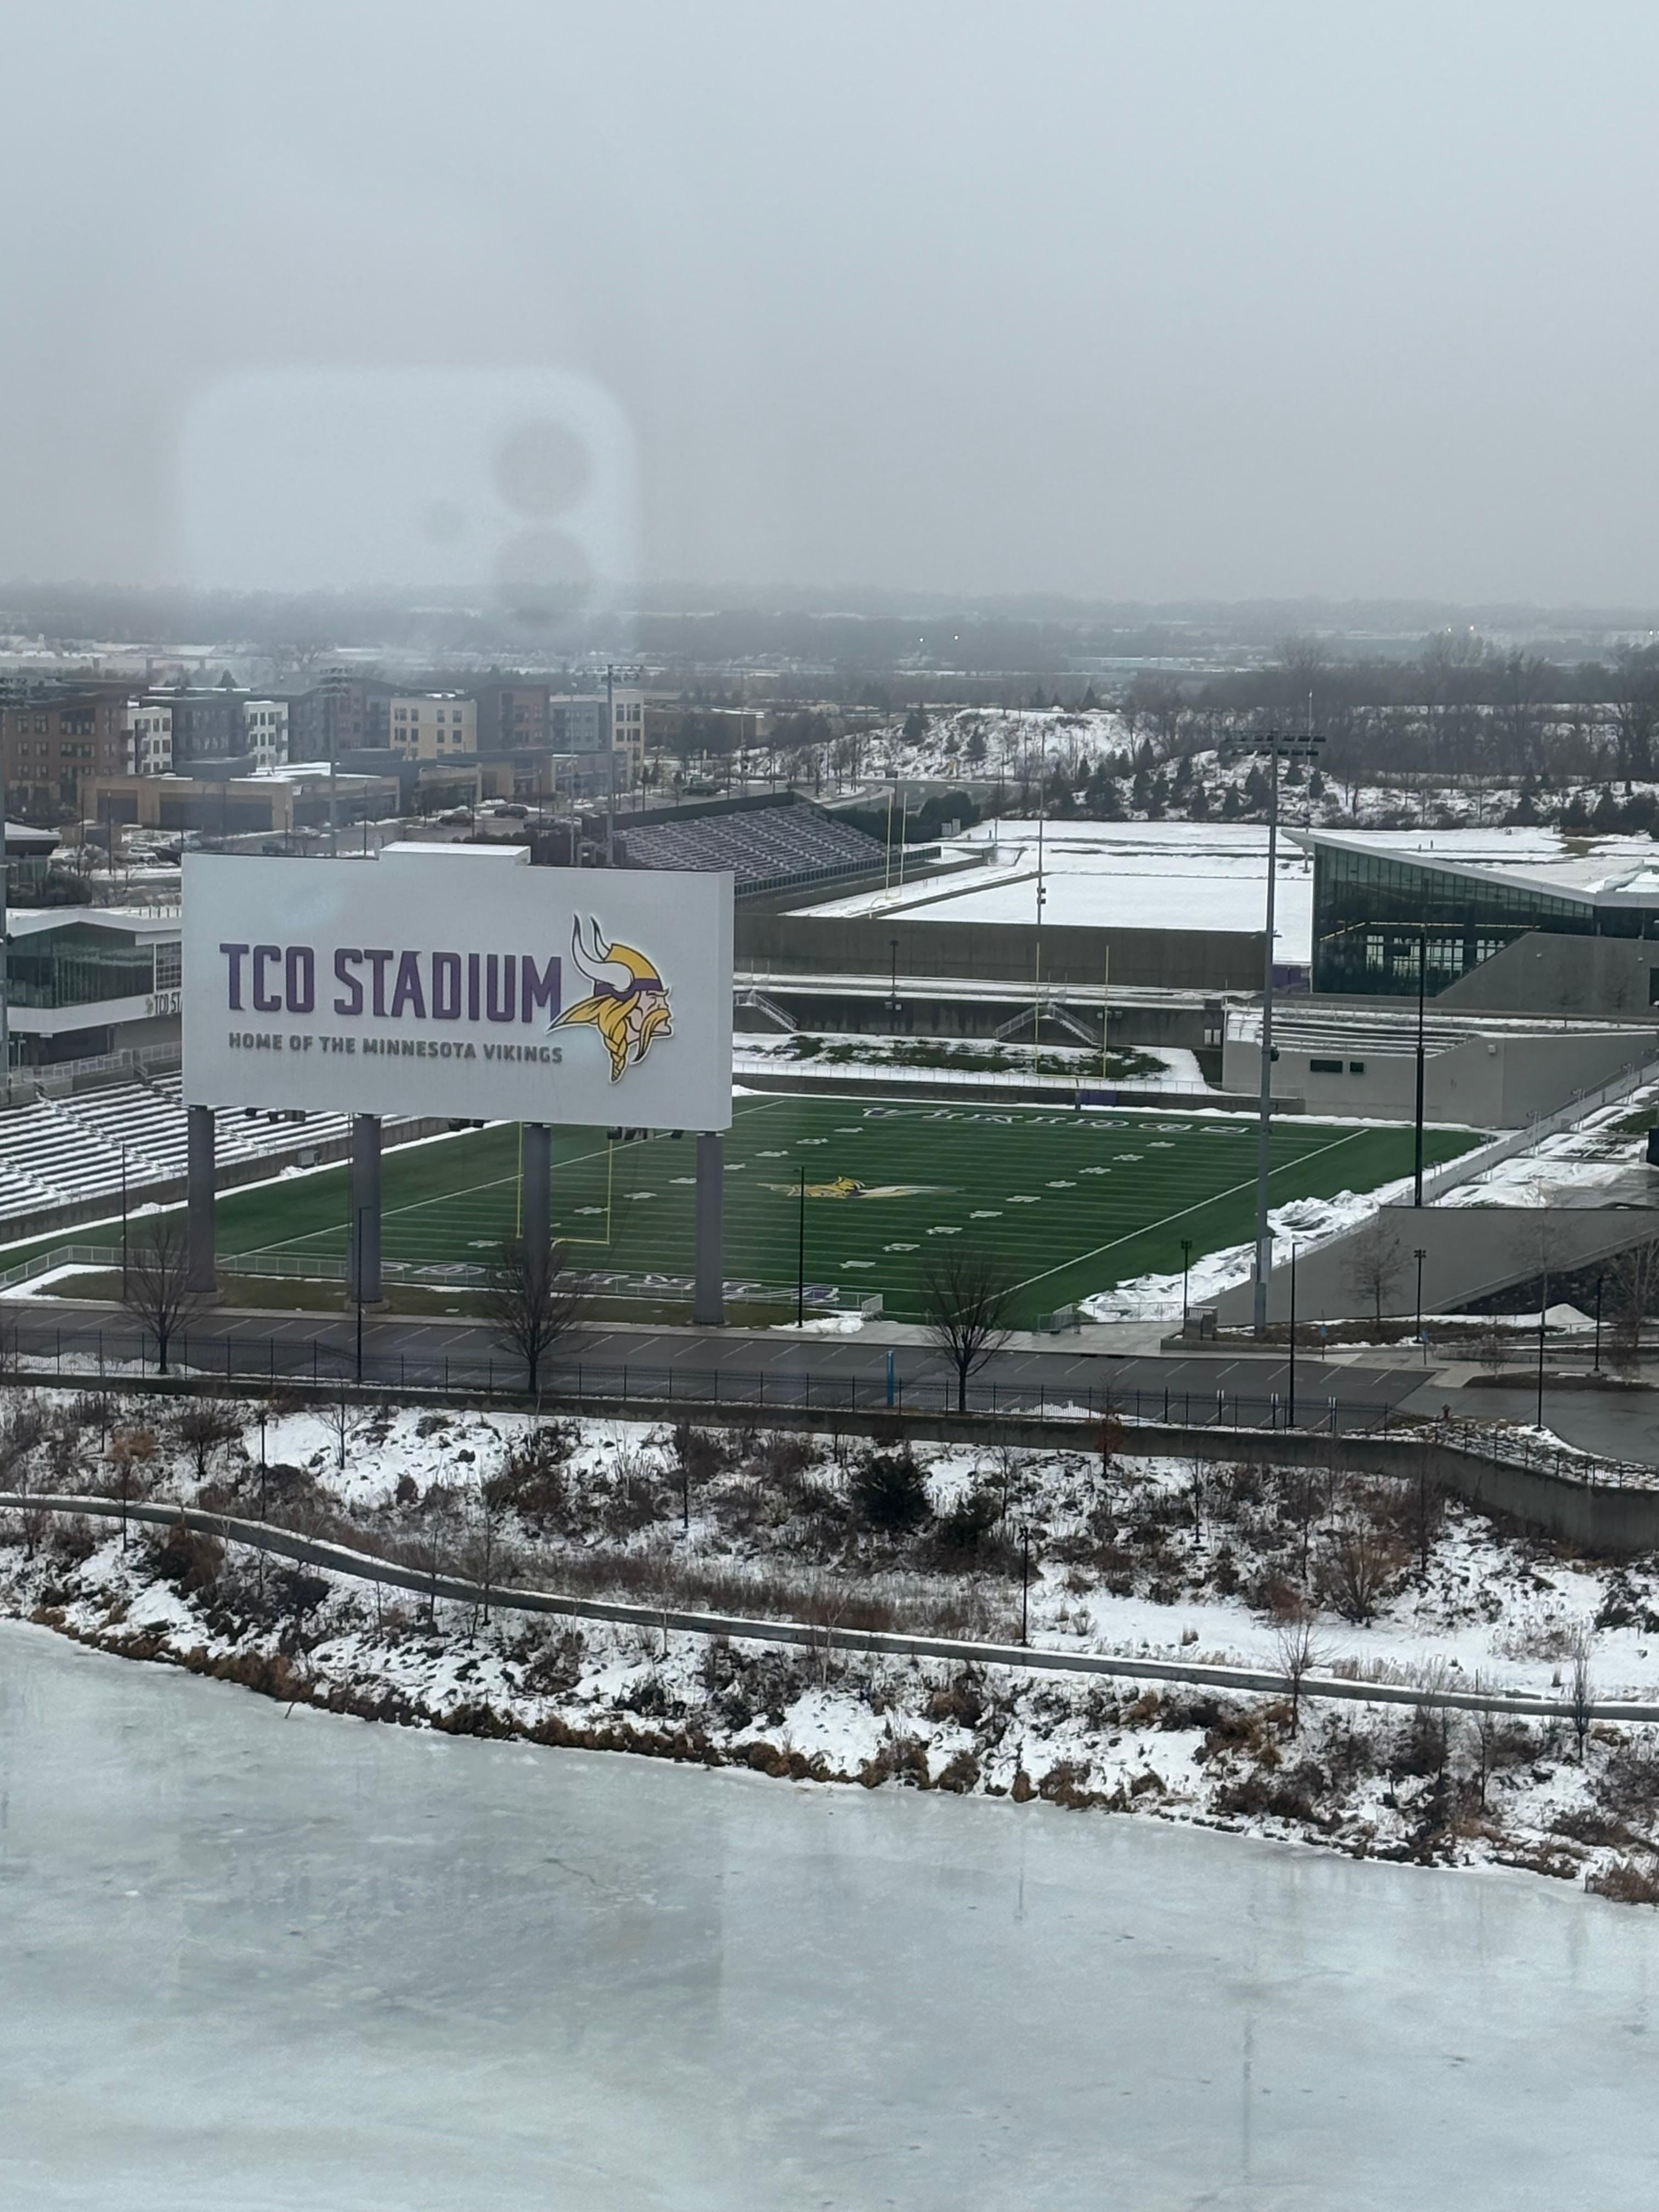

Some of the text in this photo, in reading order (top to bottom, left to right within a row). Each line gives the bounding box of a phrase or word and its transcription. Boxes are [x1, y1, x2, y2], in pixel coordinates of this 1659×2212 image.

[219, 944, 561, 1023] TCO STADIUM
[229, 1032, 562, 1063] HOME OF THE MINNESOTA VIKINGS
